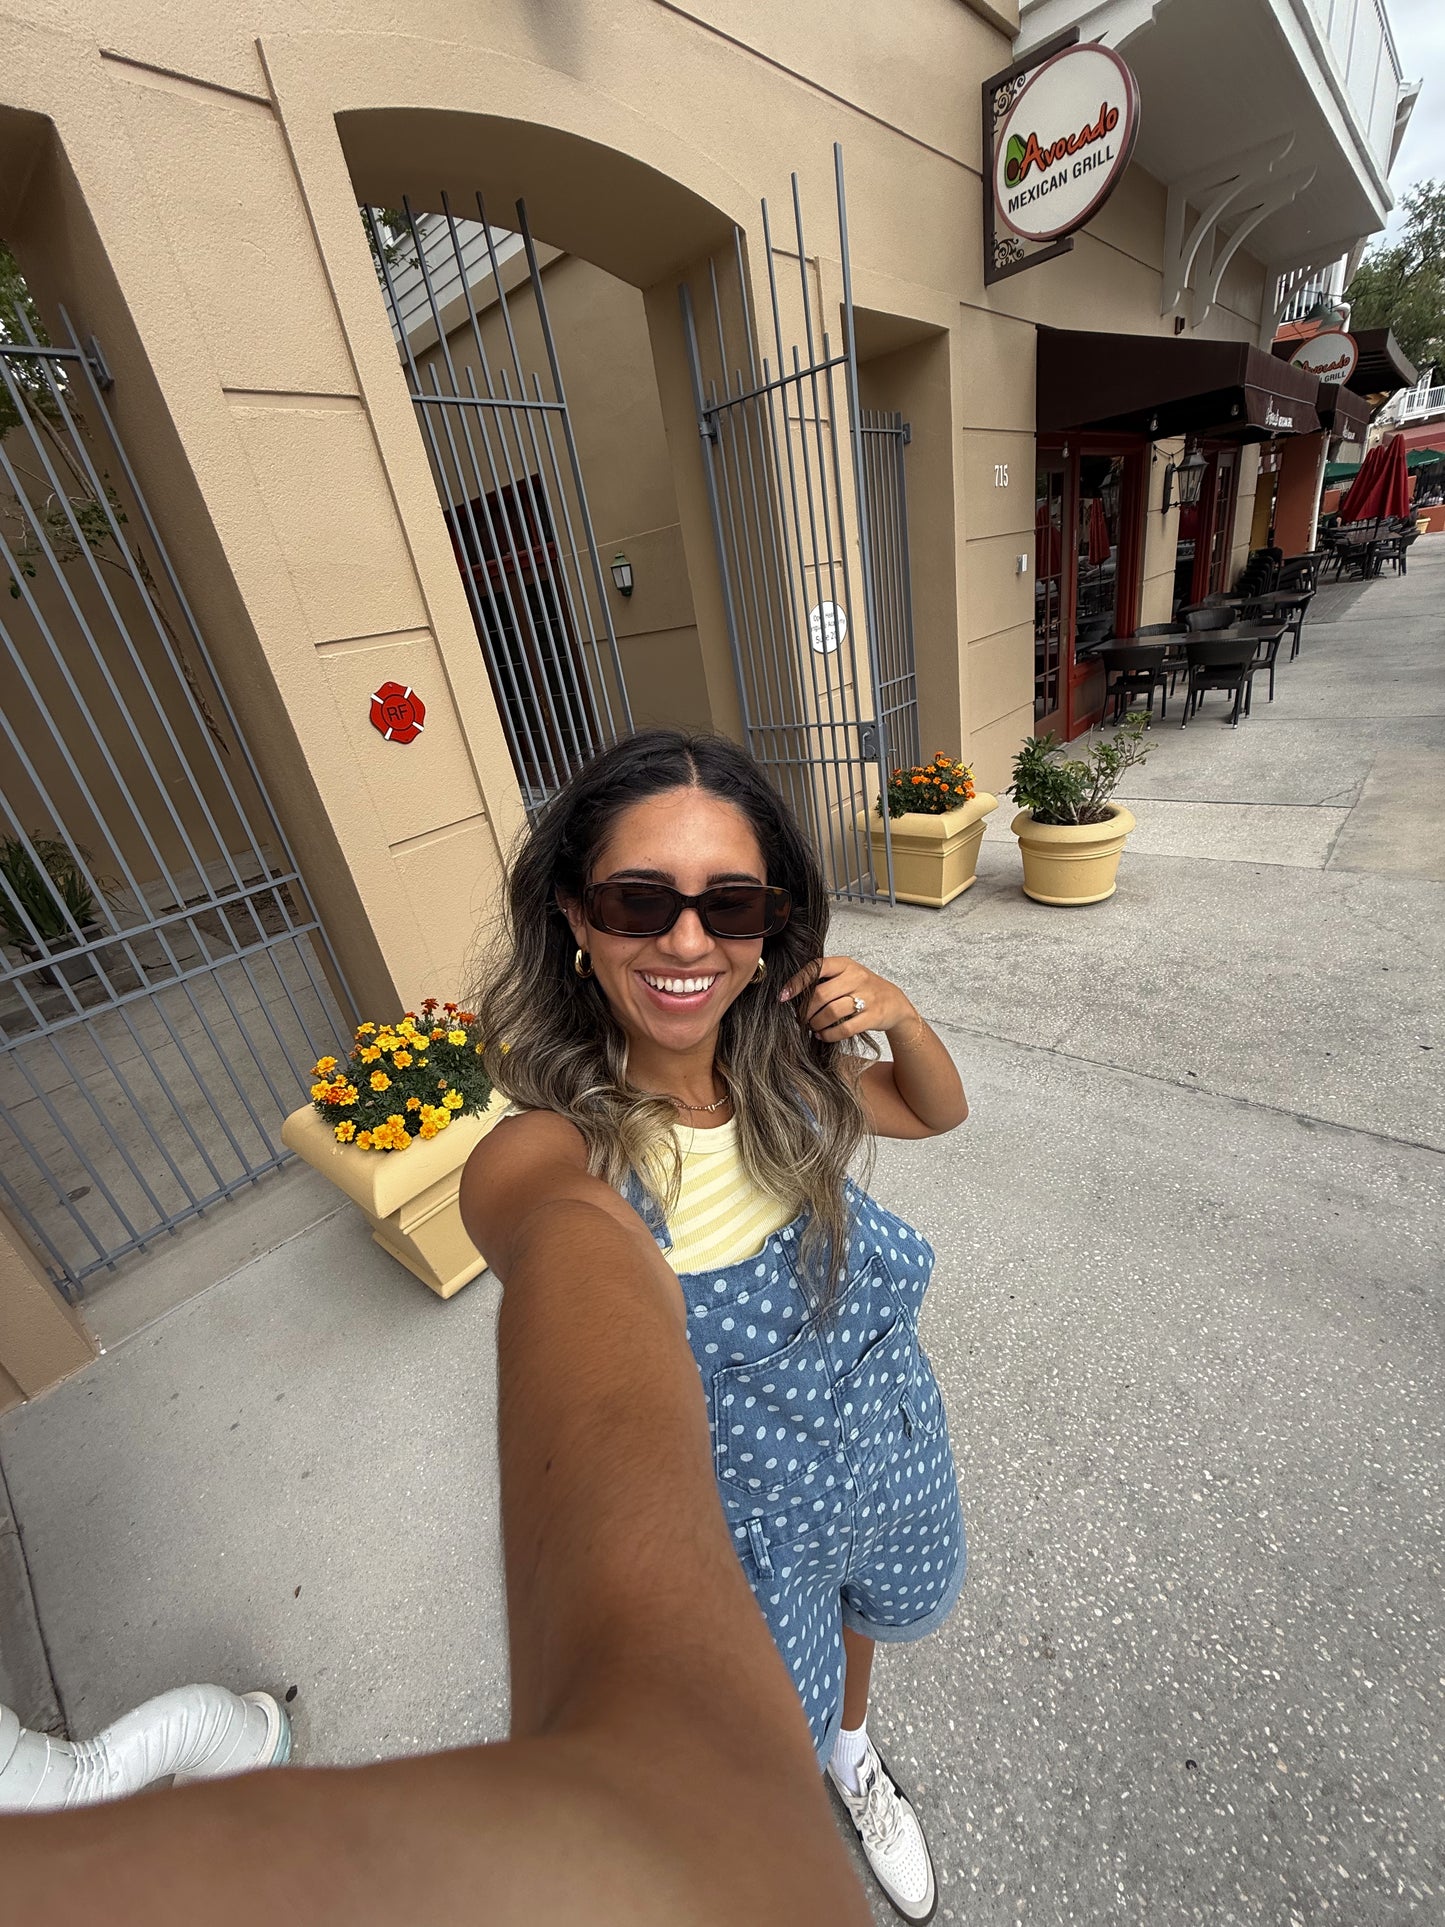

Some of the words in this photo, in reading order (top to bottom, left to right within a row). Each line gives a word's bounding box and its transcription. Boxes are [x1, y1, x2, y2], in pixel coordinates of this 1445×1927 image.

[1019, 102, 1119, 179] Avocado
[1008, 172, 1068, 214] MEXICAN
[1072, 145, 1115, 180] GRILL
[1324, 371, 1346, 382] GRILL
[994, 464, 1009, 487] 715
[386, 704, 408, 722] RF
